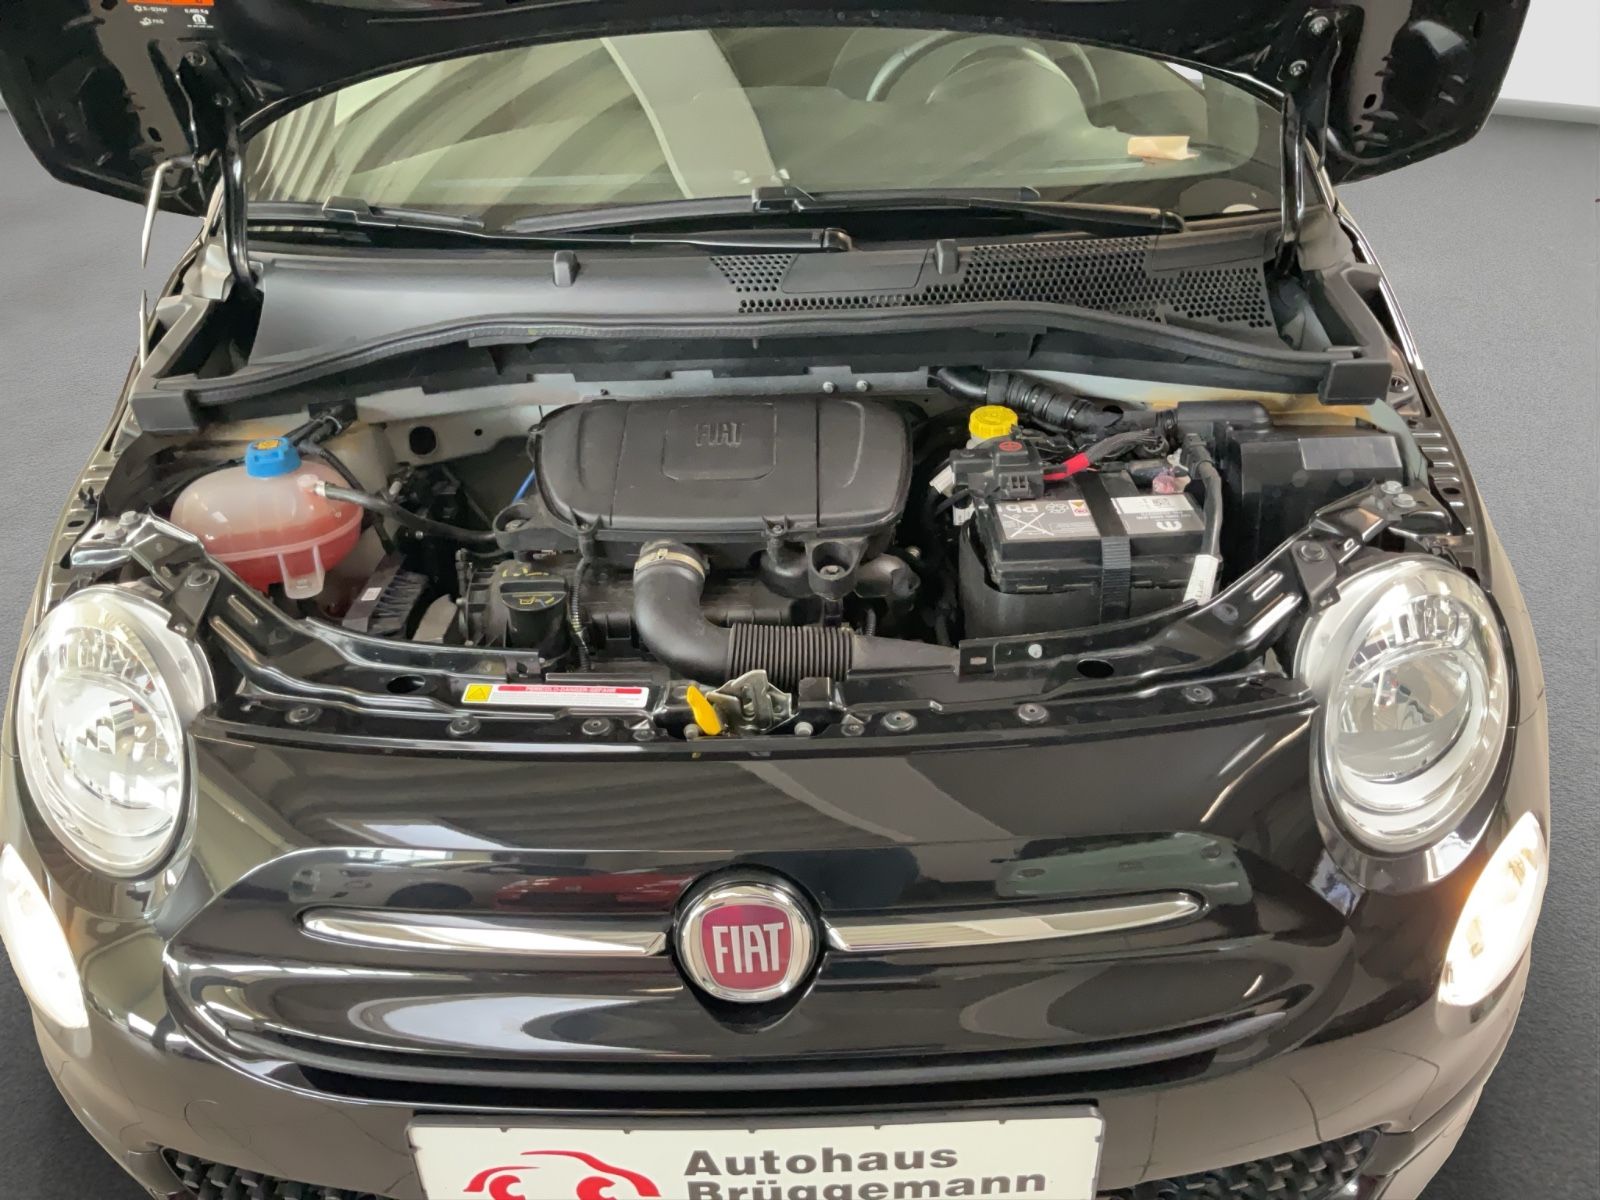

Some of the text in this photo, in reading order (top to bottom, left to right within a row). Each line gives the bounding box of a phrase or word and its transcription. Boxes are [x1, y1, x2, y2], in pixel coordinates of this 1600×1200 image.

[712, 922, 784, 973] FIAT
[684, 1147, 958, 1176] Autohaus
[687, 1173, 1046, 1200] Brüggemann
